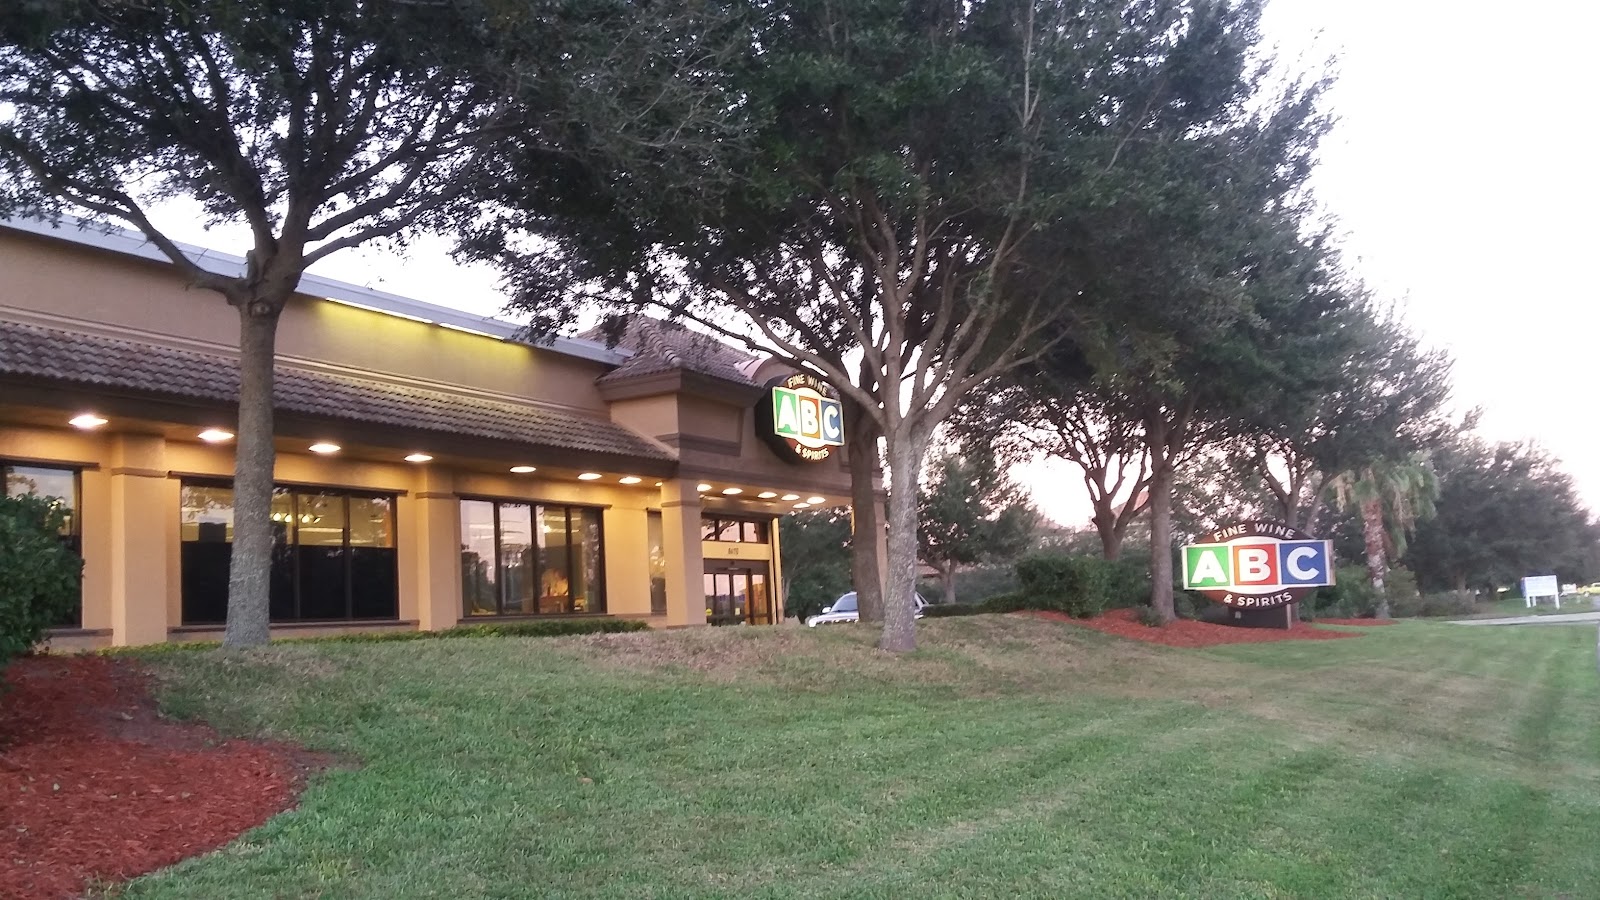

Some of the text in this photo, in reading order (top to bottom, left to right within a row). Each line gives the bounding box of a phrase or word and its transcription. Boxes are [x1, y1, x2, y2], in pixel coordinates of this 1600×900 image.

[787, 374, 827, 396] FINE WINE
[777, 394, 840, 439] ABC
[802, 447, 829, 460] SPIRITS
[1213, 522, 1296, 542] FINE WINE
[1190, 546, 1320, 584] ABC
[1223, 592, 1293, 607] & SPIRITS
